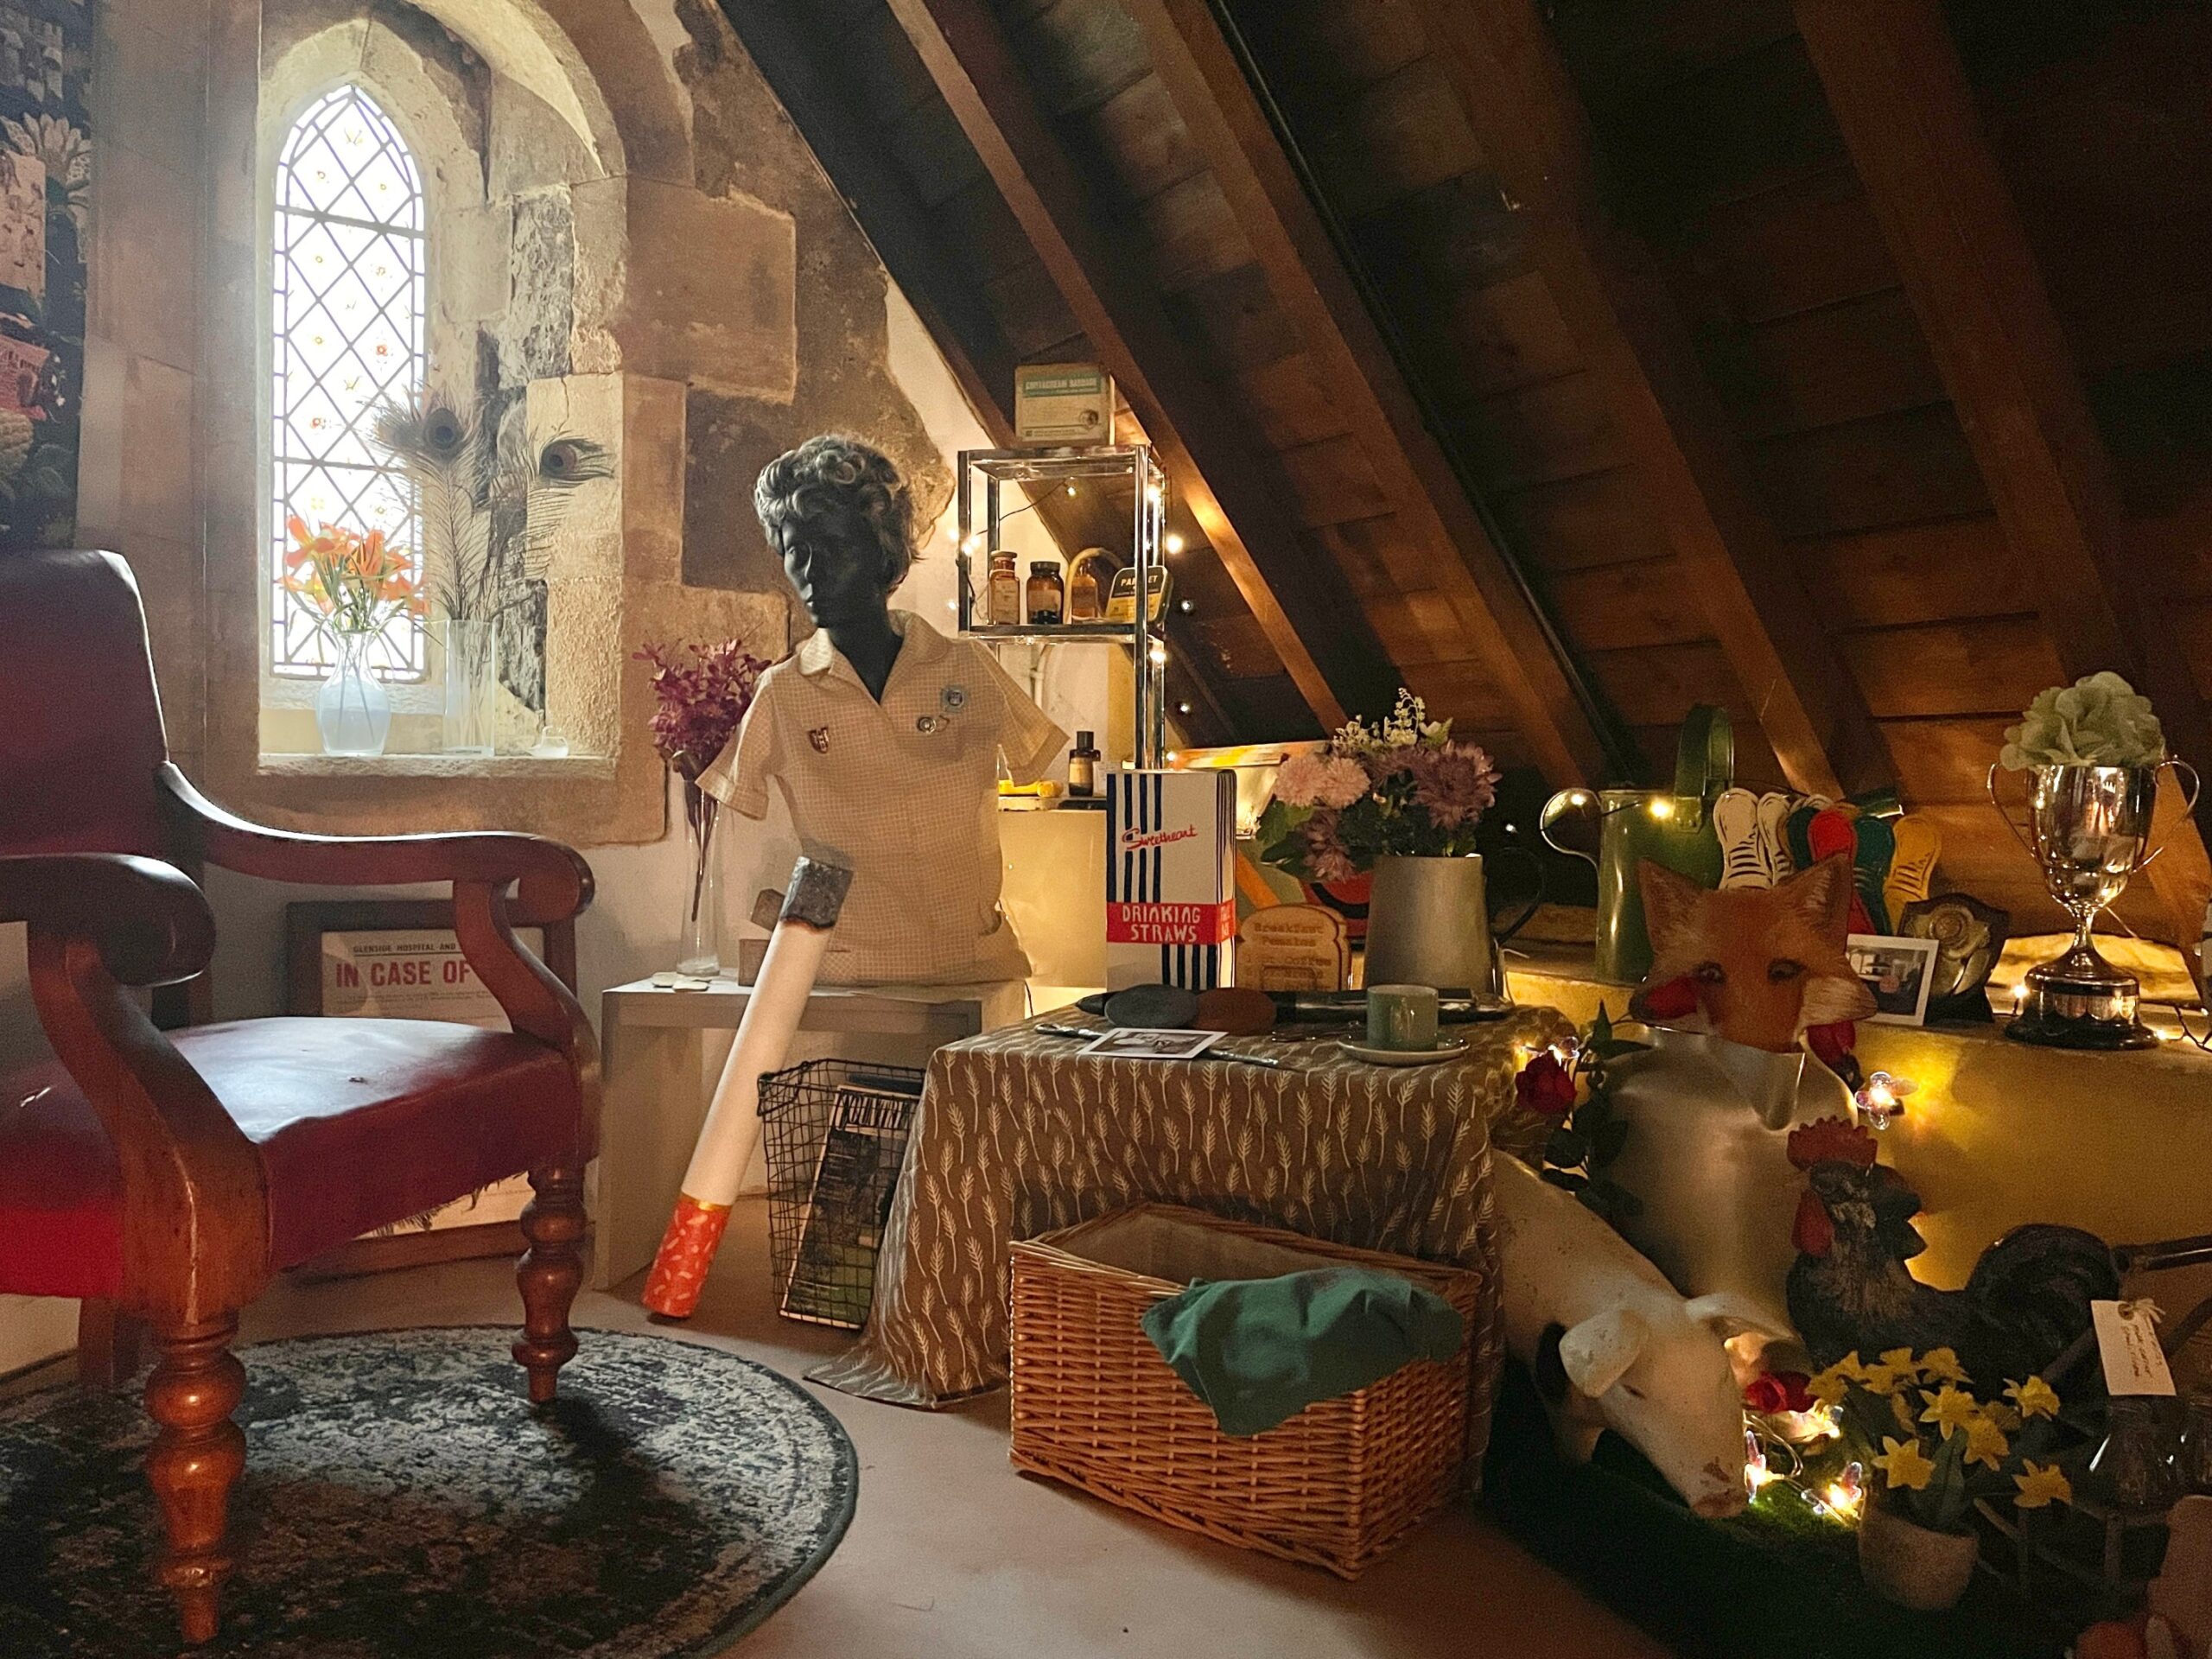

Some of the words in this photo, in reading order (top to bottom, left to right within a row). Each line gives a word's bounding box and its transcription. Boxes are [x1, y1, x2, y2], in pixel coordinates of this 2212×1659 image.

[1122, 824, 1198, 850] Sweetheart
[1122, 905, 1201, 924] DRINKING
[1130, 924, 1198, 943] STRAWS
[1255, 923, 1324, 934] Breakfast
[397, 943, 435, 951] HOSPITAL
[336, 962, 359, 988] IN
[371, 961, 431, 986] CASE
[443, 960, 471, 983] OF
